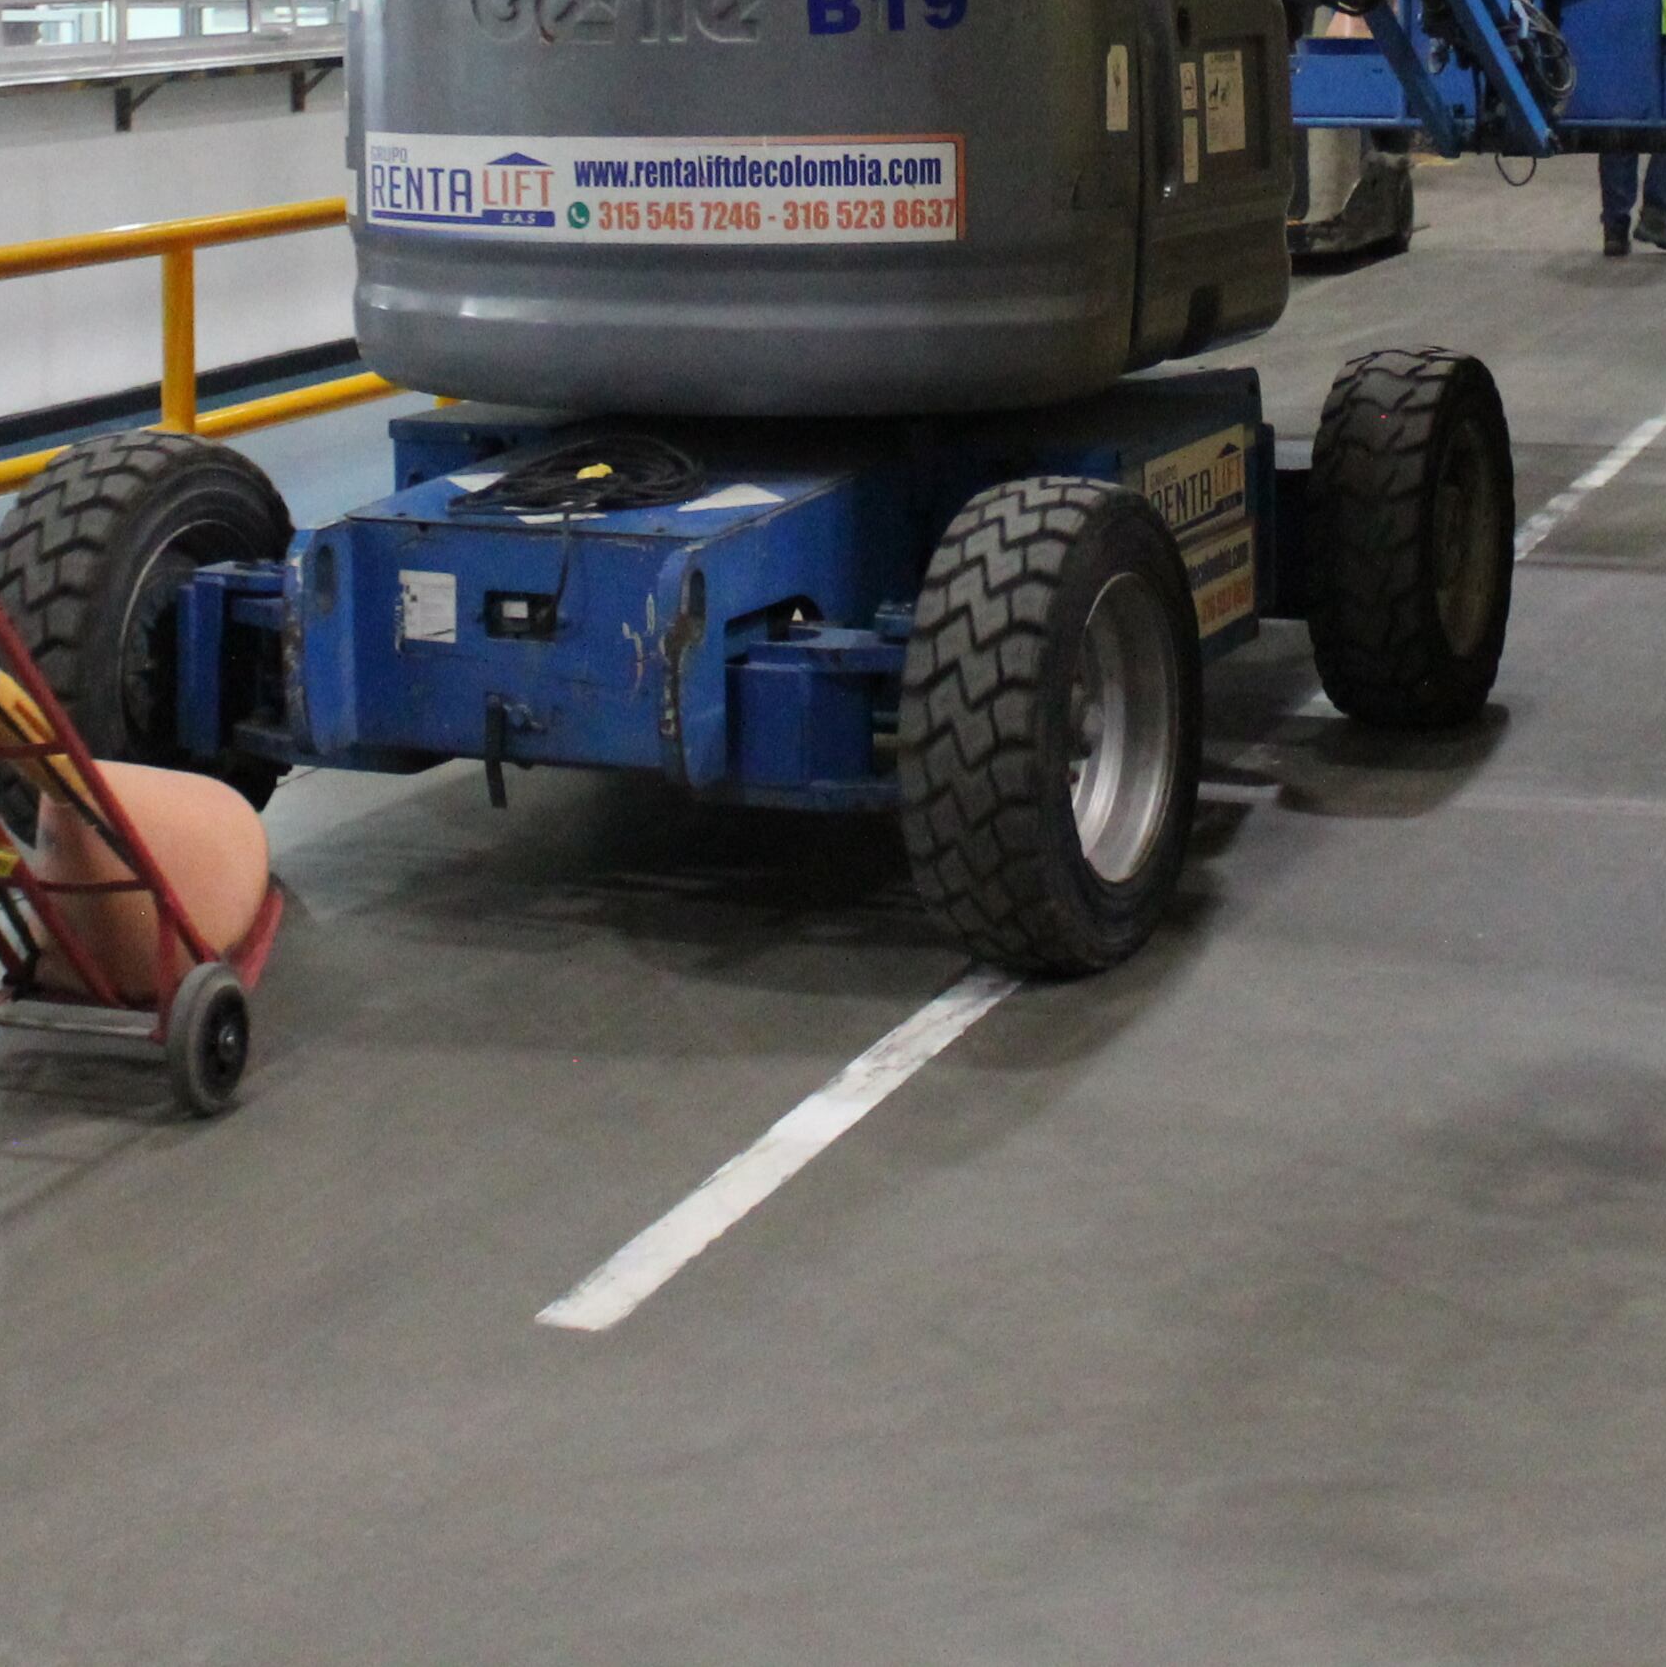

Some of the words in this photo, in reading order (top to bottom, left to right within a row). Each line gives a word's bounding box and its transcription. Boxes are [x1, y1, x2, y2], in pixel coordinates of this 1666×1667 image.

[574, 152, 941, 188] www.rentaliftdecolombia.com
[372, 164, 472, 213] RENTA
[483, 170, 554, 207] LIFT
[598, 202, 640, 230] 315
[645, 201, 695, 230] 545
[700, 200, 761, 230] 7246
[783, 199, 831, 229] 316
[836, 198, 886, 229] 523
[893, 197, 957, 229] 8637
